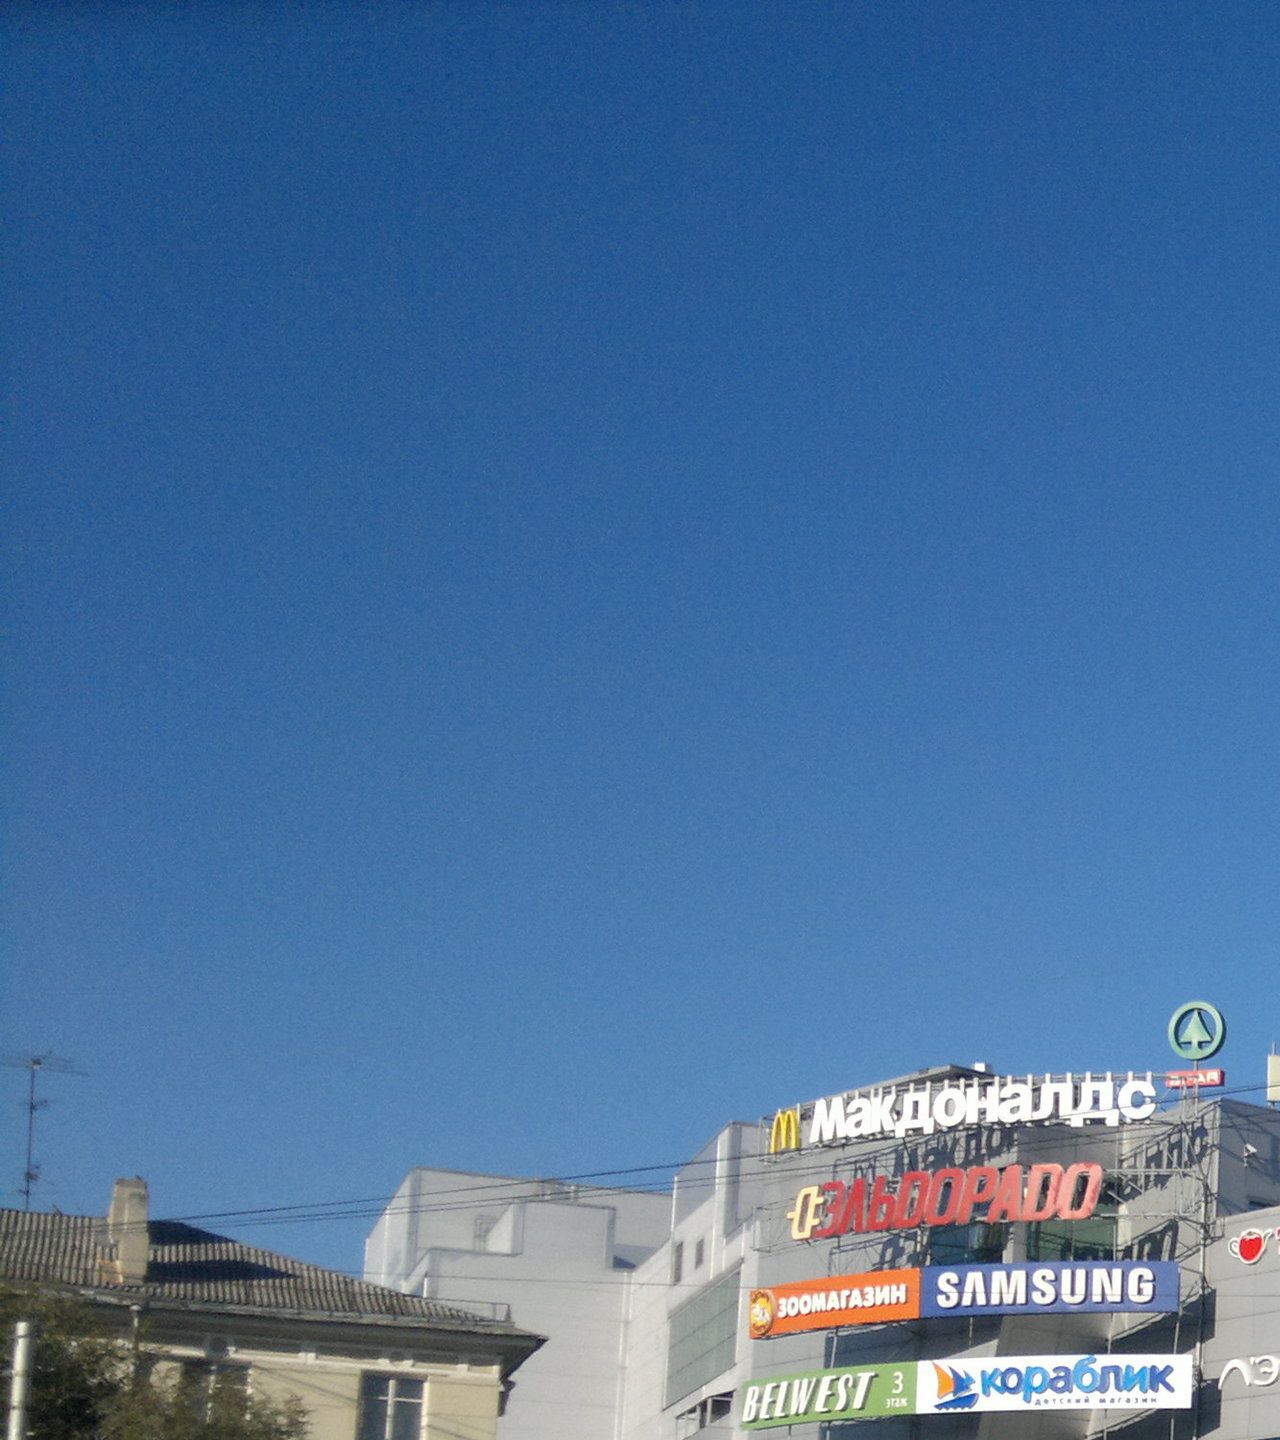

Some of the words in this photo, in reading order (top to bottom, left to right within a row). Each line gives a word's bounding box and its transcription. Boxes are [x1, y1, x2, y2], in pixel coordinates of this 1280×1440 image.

[808, 1076, 1158, 1145] Макдоналдс
[778, 1284, 907, 1319] ЗООМАГАЗИН
[936, 1266, 1156, 1308] SAMSUNG
[742, 1371, 879, 1423] BELWEST
[892, 1371, 904, 1394] 3
[980, 1353, 1176, 1404] кораблик
